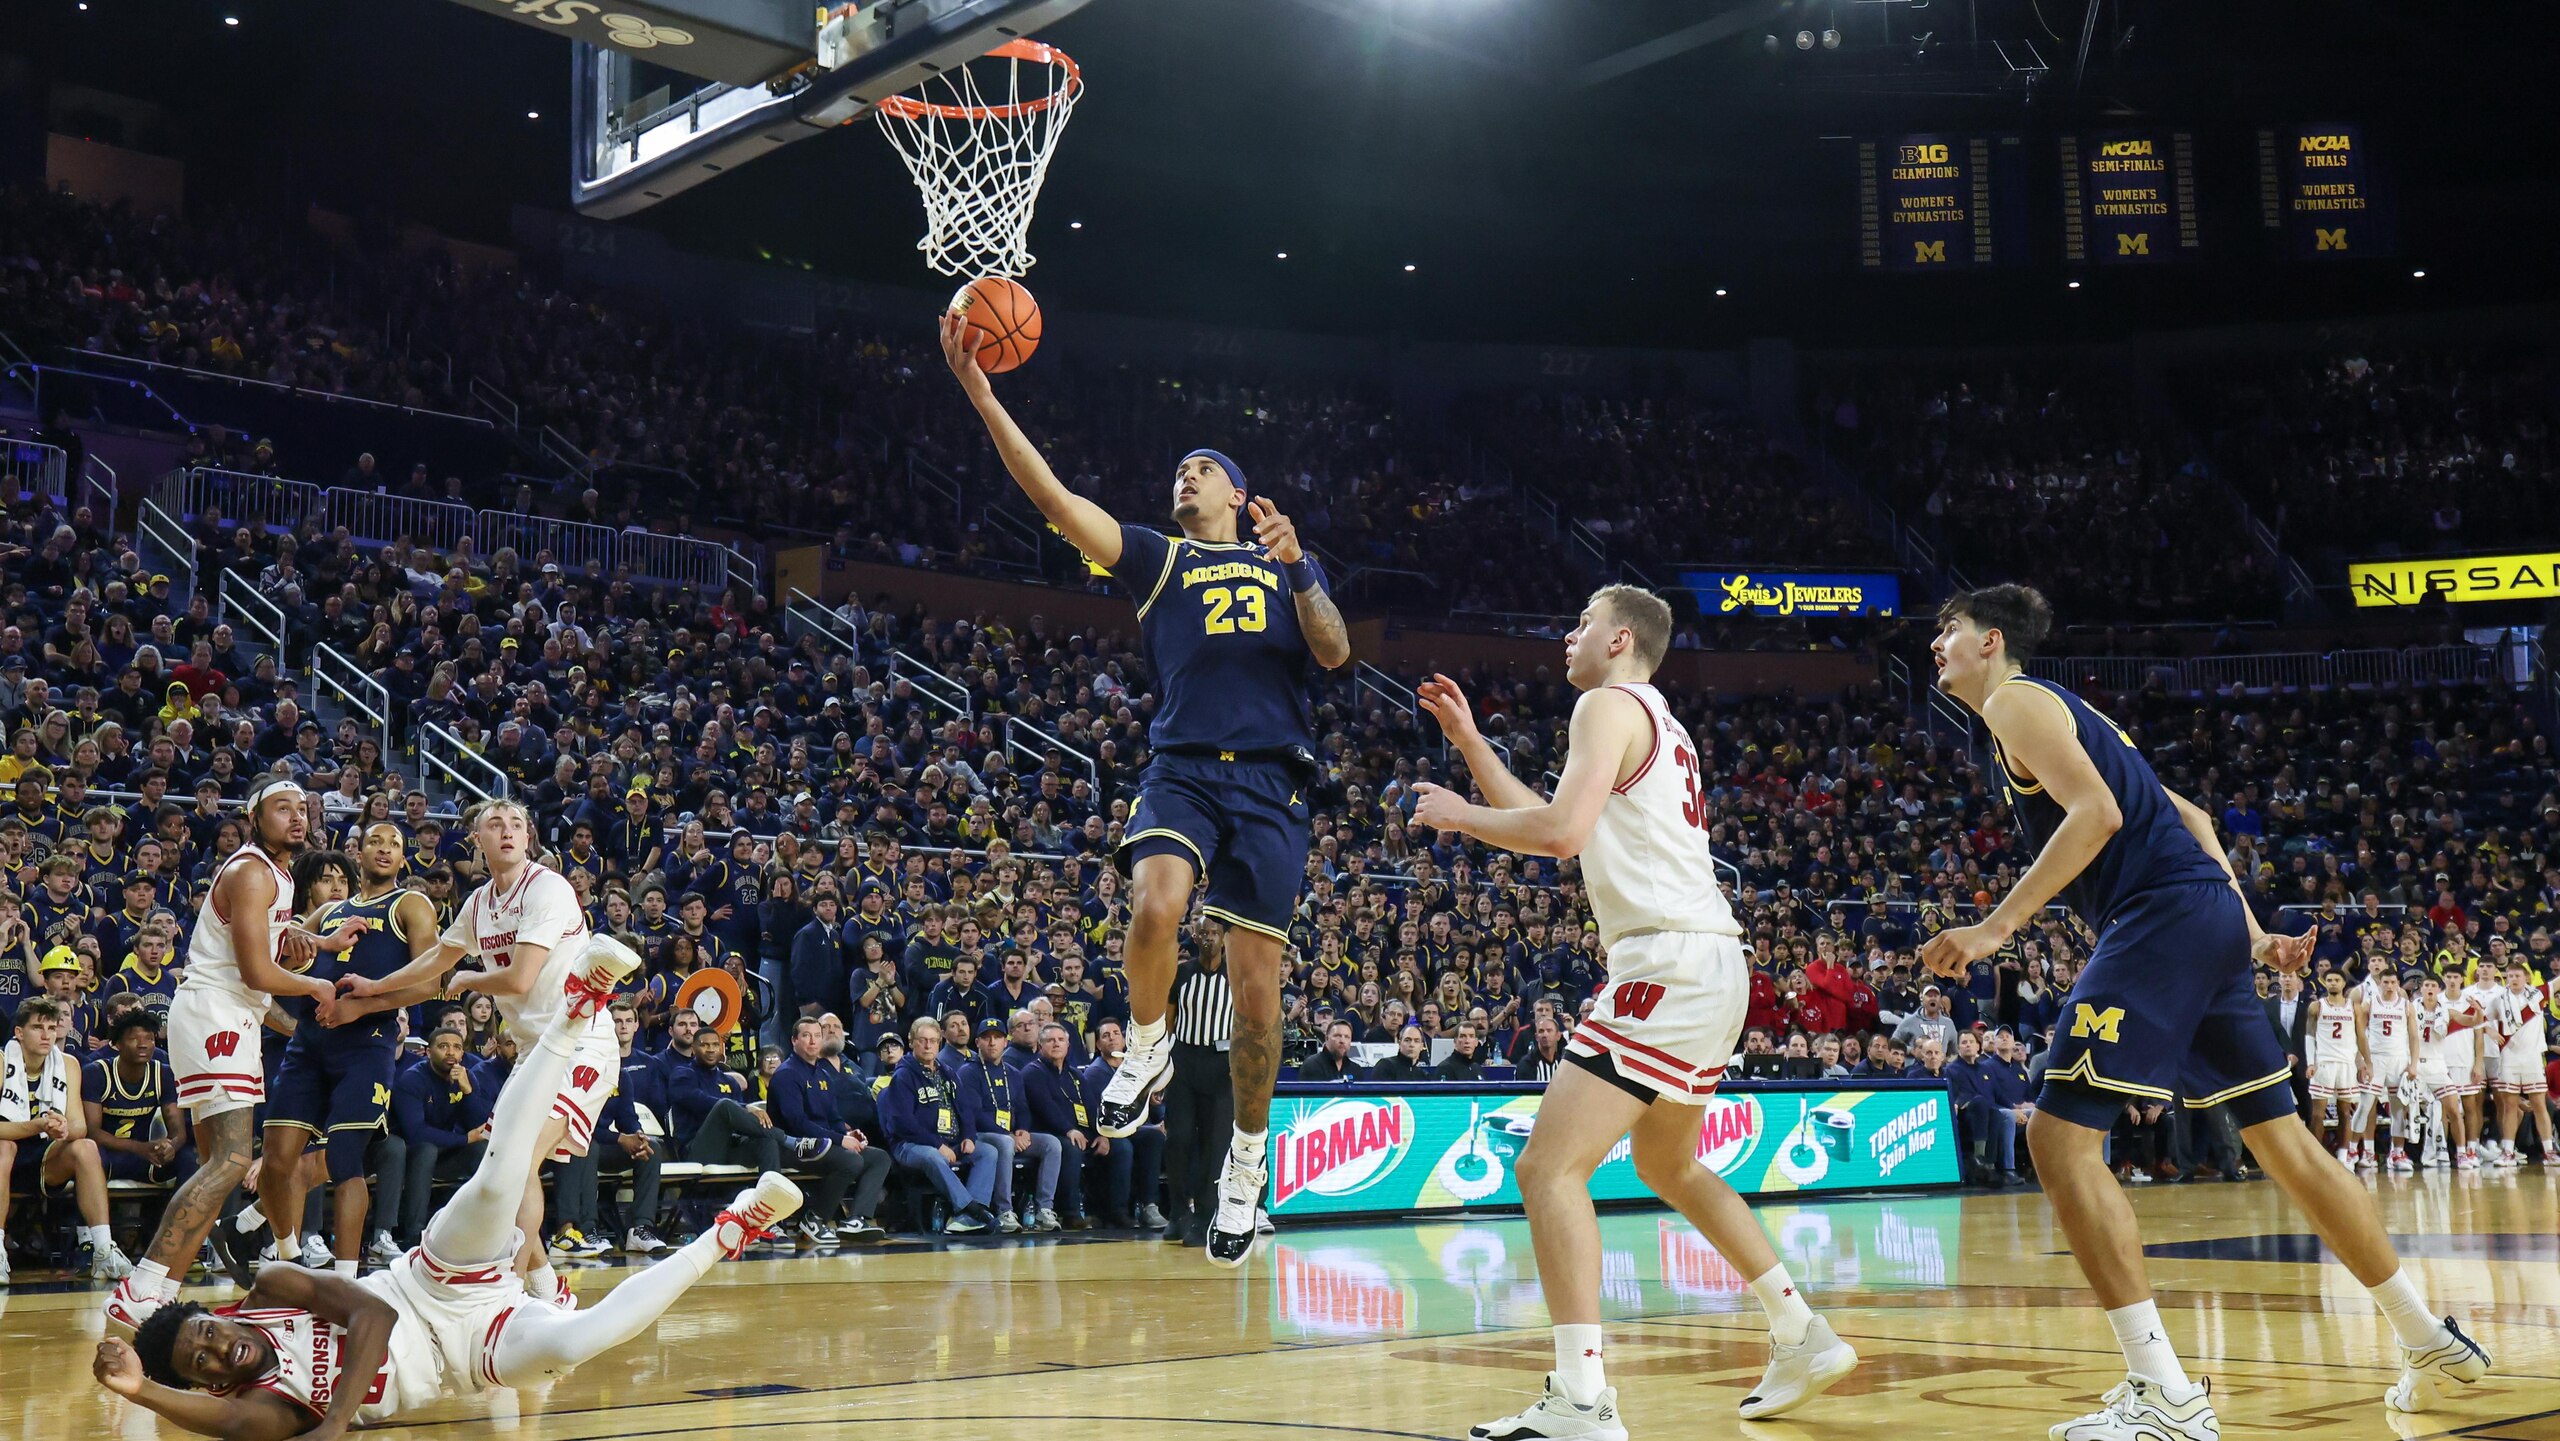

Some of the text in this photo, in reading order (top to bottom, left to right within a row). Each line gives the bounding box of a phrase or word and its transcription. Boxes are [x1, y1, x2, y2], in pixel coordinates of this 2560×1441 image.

[495, 0, 601, 26] St
[2101, 139, 2153, 157] NCAA
[2300, 135, 2351, 152] NCAA
[2091, 159, 2166, 173] SEMI-FINALS
[2305, 155, 2348, 168] FINALS
[1892, 166, 1960, 180] CHAMPIONS
[2102, 189, 2158, 201] WOMEN'S
[2302, 184, 2356, 196] WOMEN'S
[1901, 196, 1955, 208] WOMEN'S
[2095, 203, 2168, 216] GYMNASTICS
[2294, 197, 2367, 211] GYMNASTICS
[1893, 209, 1965, 223] GYMNASTICS
[2117, 233, 2149, 255] M
[2315, 227, 2349, 251] M
[1914, 240, 1947, 263] M
[1182, 562, 1278, 591] MICHIGAN
[2364, 563, 2560, 598] NISSA
[1779, 582, 1862, 615] JEWELERS
[1202, 586, 1267, 635] 23
[321, 917, 385, 933] MICAN
[480, 930, 519, 951] WISCONSI
[64, 957, 75, 965] M
[1613, 981, 1666, 1021] W
[2070, 1003, 2126, 1043] M
[2322, 1014, 2353, 1023] WISCONSIN
[2373, 1013, 2402, 1021] WISCONSIN
[2332, 1022, 2342, 1039] 2
[2382, 1021, 2392, 1036] 5
[2422, 1026, 2431, 1042] 4
[205, 1031, 239, 1061] W
[572, 1065, 599, 1093] W
[372, 1082, 391, 1110] M
[115, 1119, 135, 1139] 2
[1697, 1101, 1753, 1158] MAN
[1869, 1098, 1937, 1158] TORNADO
[1275, 1104, 1402, 1206] LIBMAN
[1879, 1130, 1936, 1178] Spin Mop
